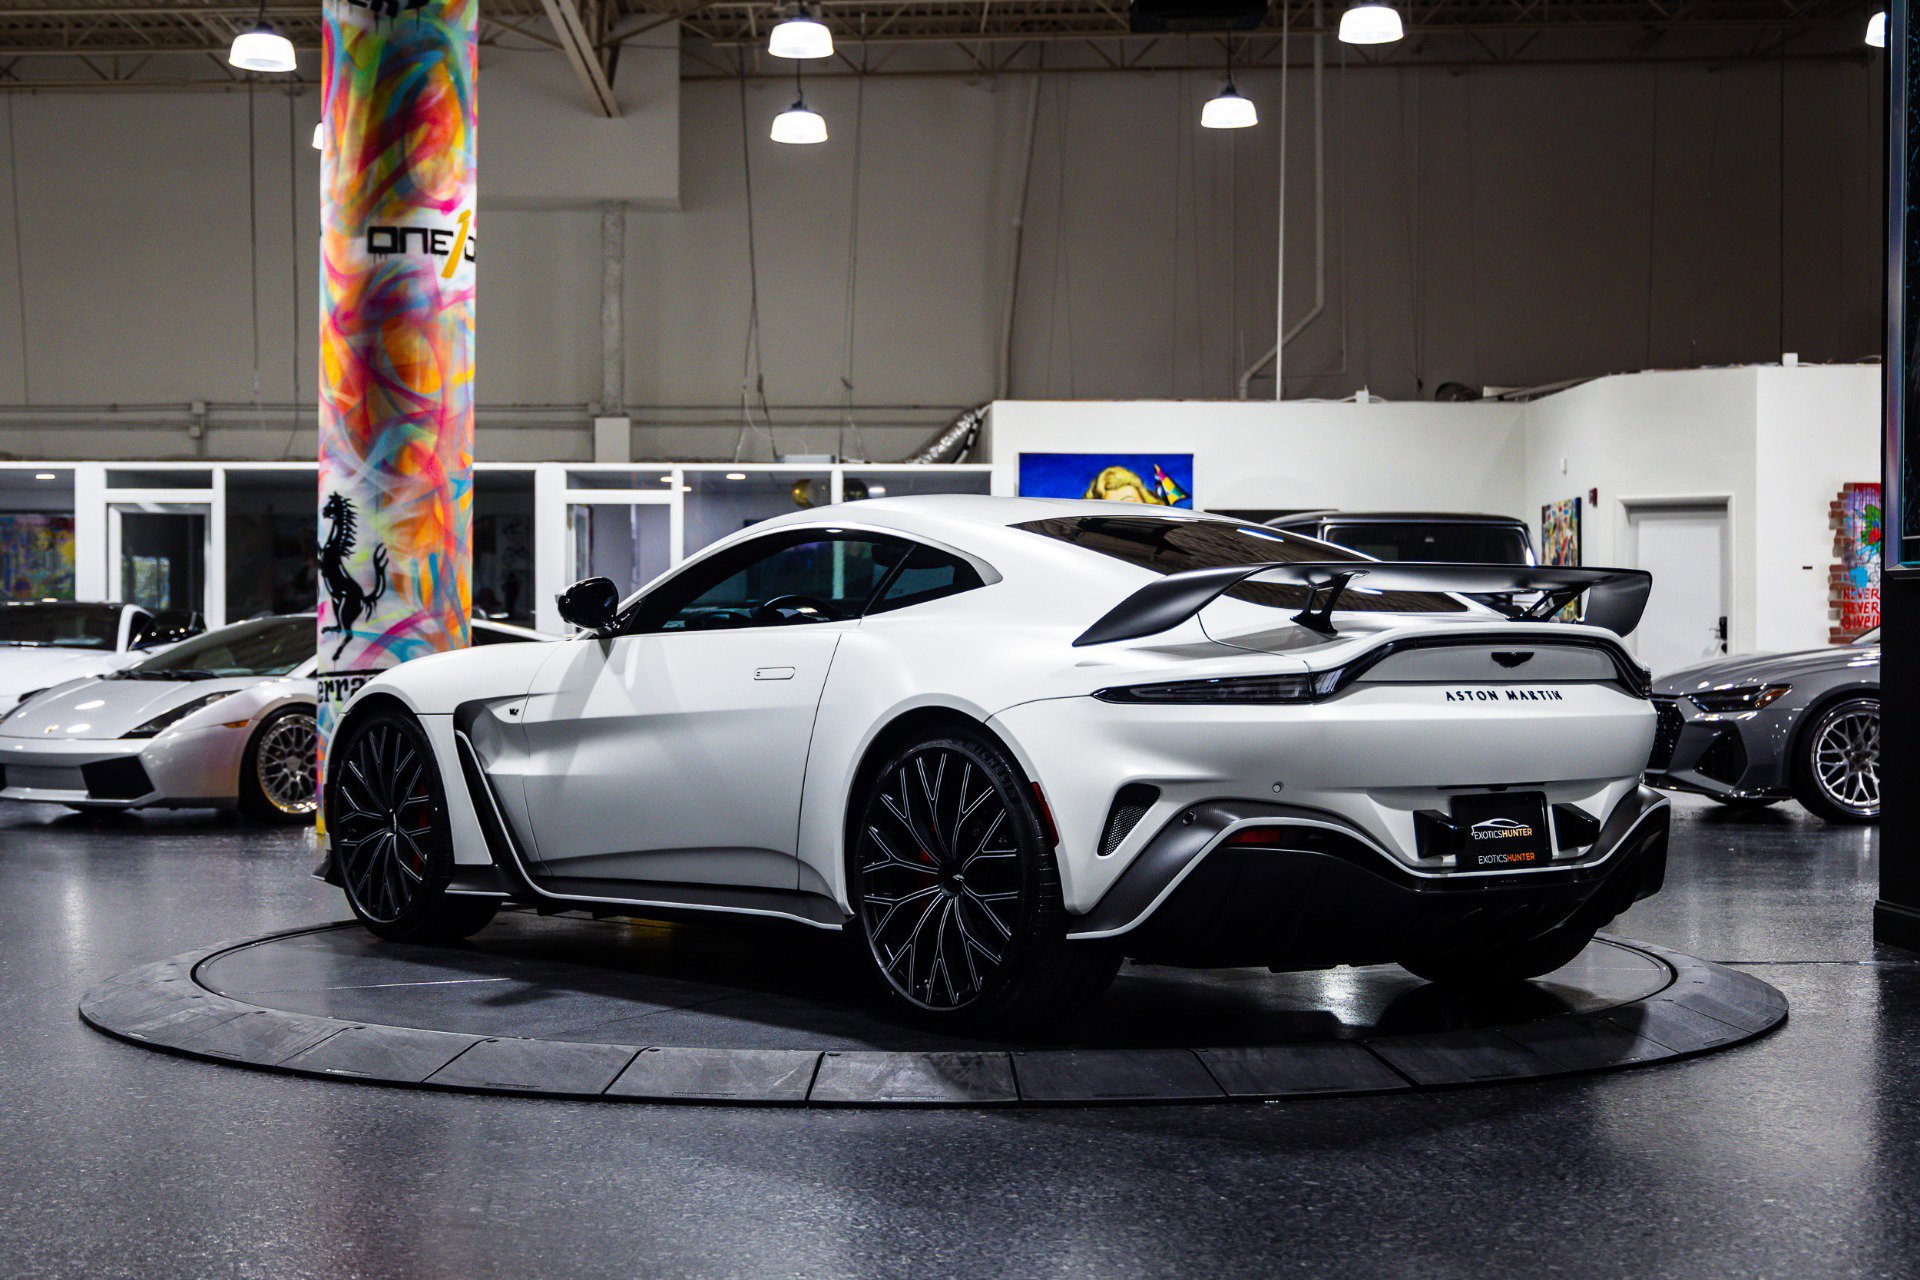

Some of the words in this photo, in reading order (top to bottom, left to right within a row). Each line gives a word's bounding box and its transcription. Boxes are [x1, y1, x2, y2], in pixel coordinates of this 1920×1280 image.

[1843, 601, 1880, 615] NEVER
[1446, 690, 1498, 701] ASTON
[1505, 690, 1562, 700] MARTIN
[1474, 828, 1533, 840] EXOTICSHUNTER
[1478, 852, 1535, 865] EXOTICSHUNTER
